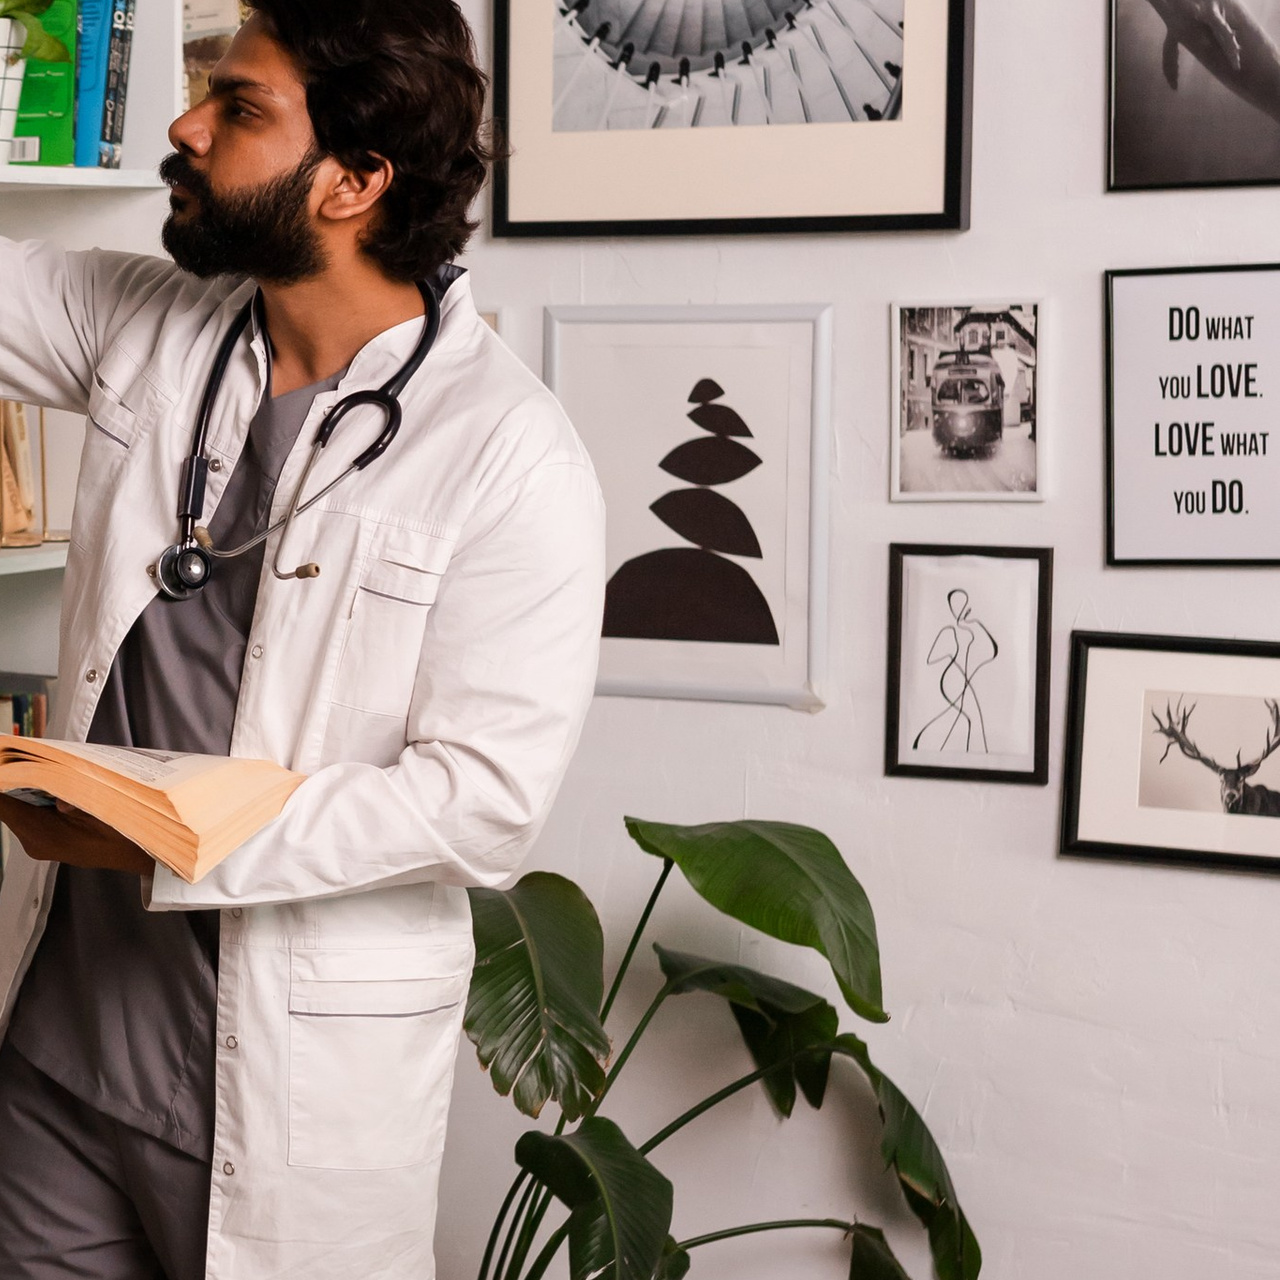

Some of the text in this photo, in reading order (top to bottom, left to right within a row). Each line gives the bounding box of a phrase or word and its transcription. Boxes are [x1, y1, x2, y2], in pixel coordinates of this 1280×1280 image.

[1168, 306, 1255, 342] DO WHAT
[1159, 362, 1264, 400] YOU LOVE.
[1153, 421, 1270, 457] LOVE WHAT
[1173, 478, 1249, 515] YOU DO.
